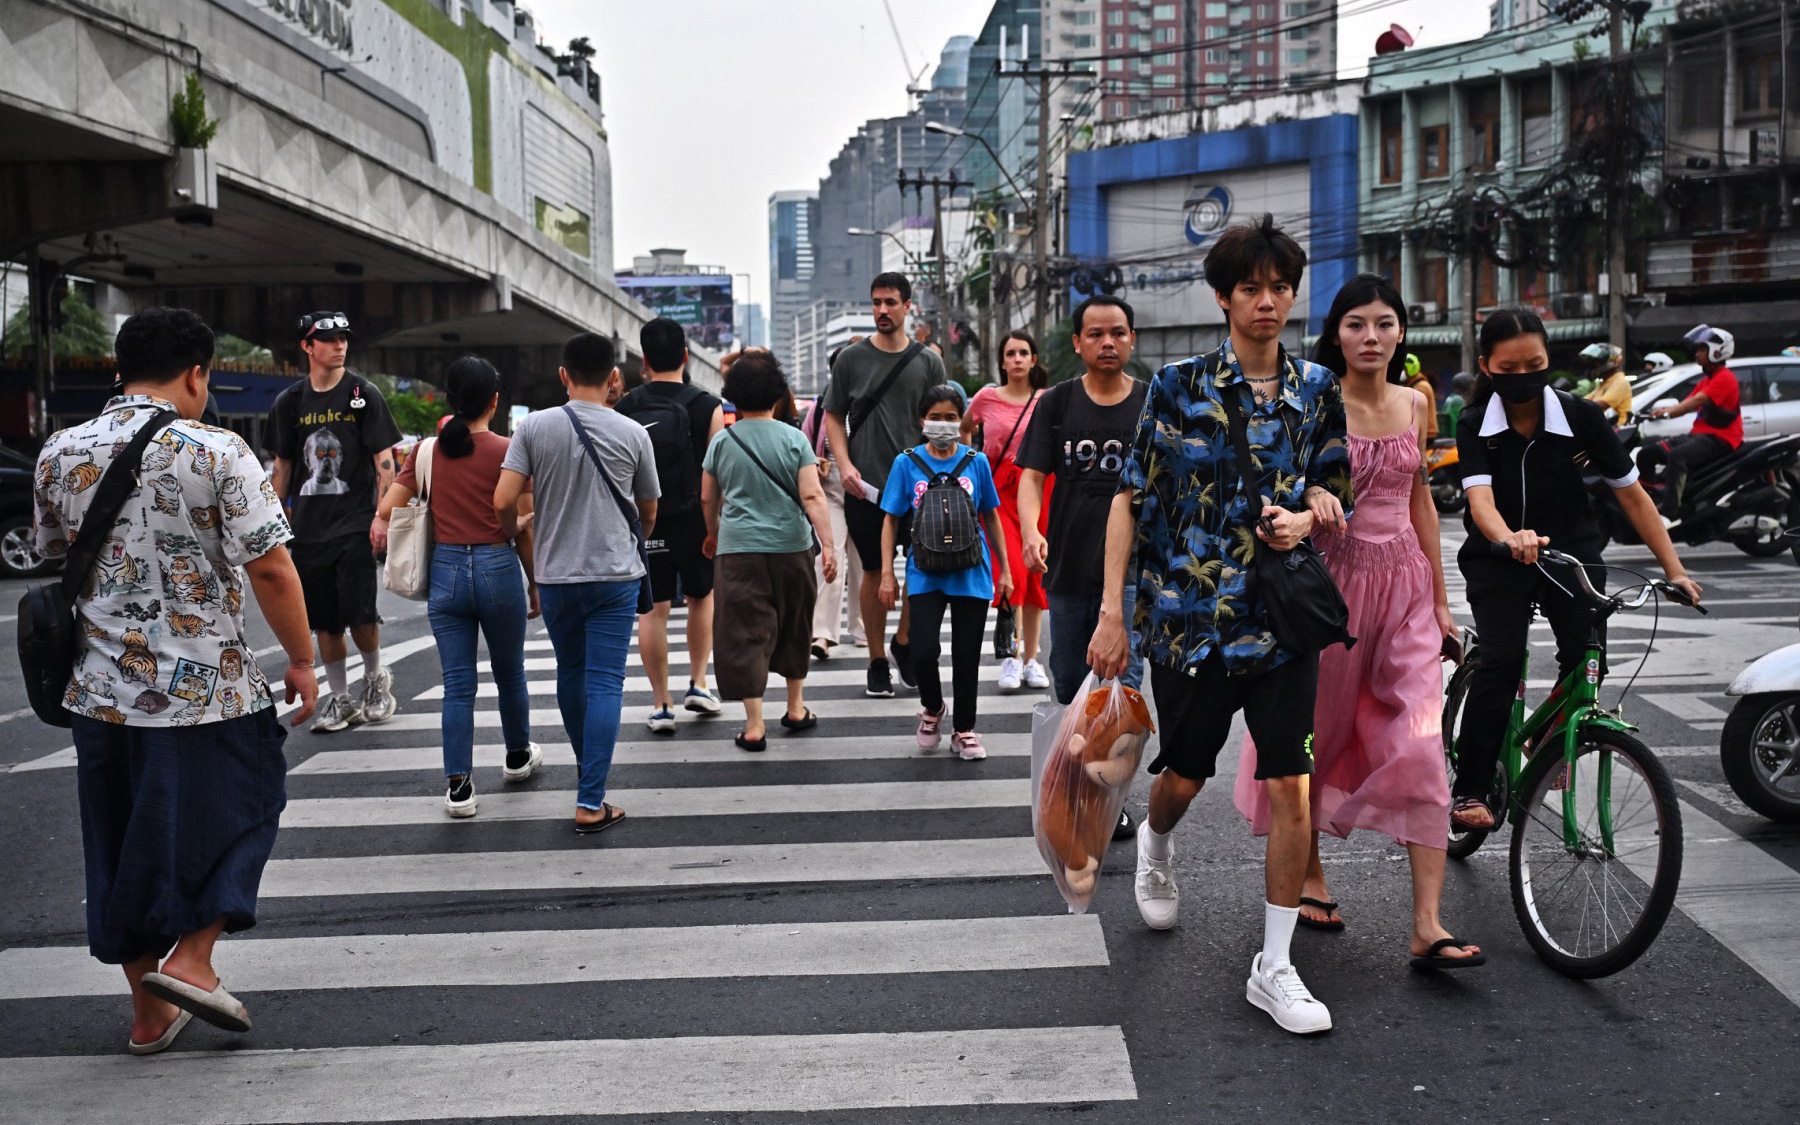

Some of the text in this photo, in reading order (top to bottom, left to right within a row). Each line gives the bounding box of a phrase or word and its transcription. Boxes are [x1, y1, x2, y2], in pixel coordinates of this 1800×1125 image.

[1069, 430, 1134, 438] NEW YOR
[1064, 439, 1132, 474] 198
